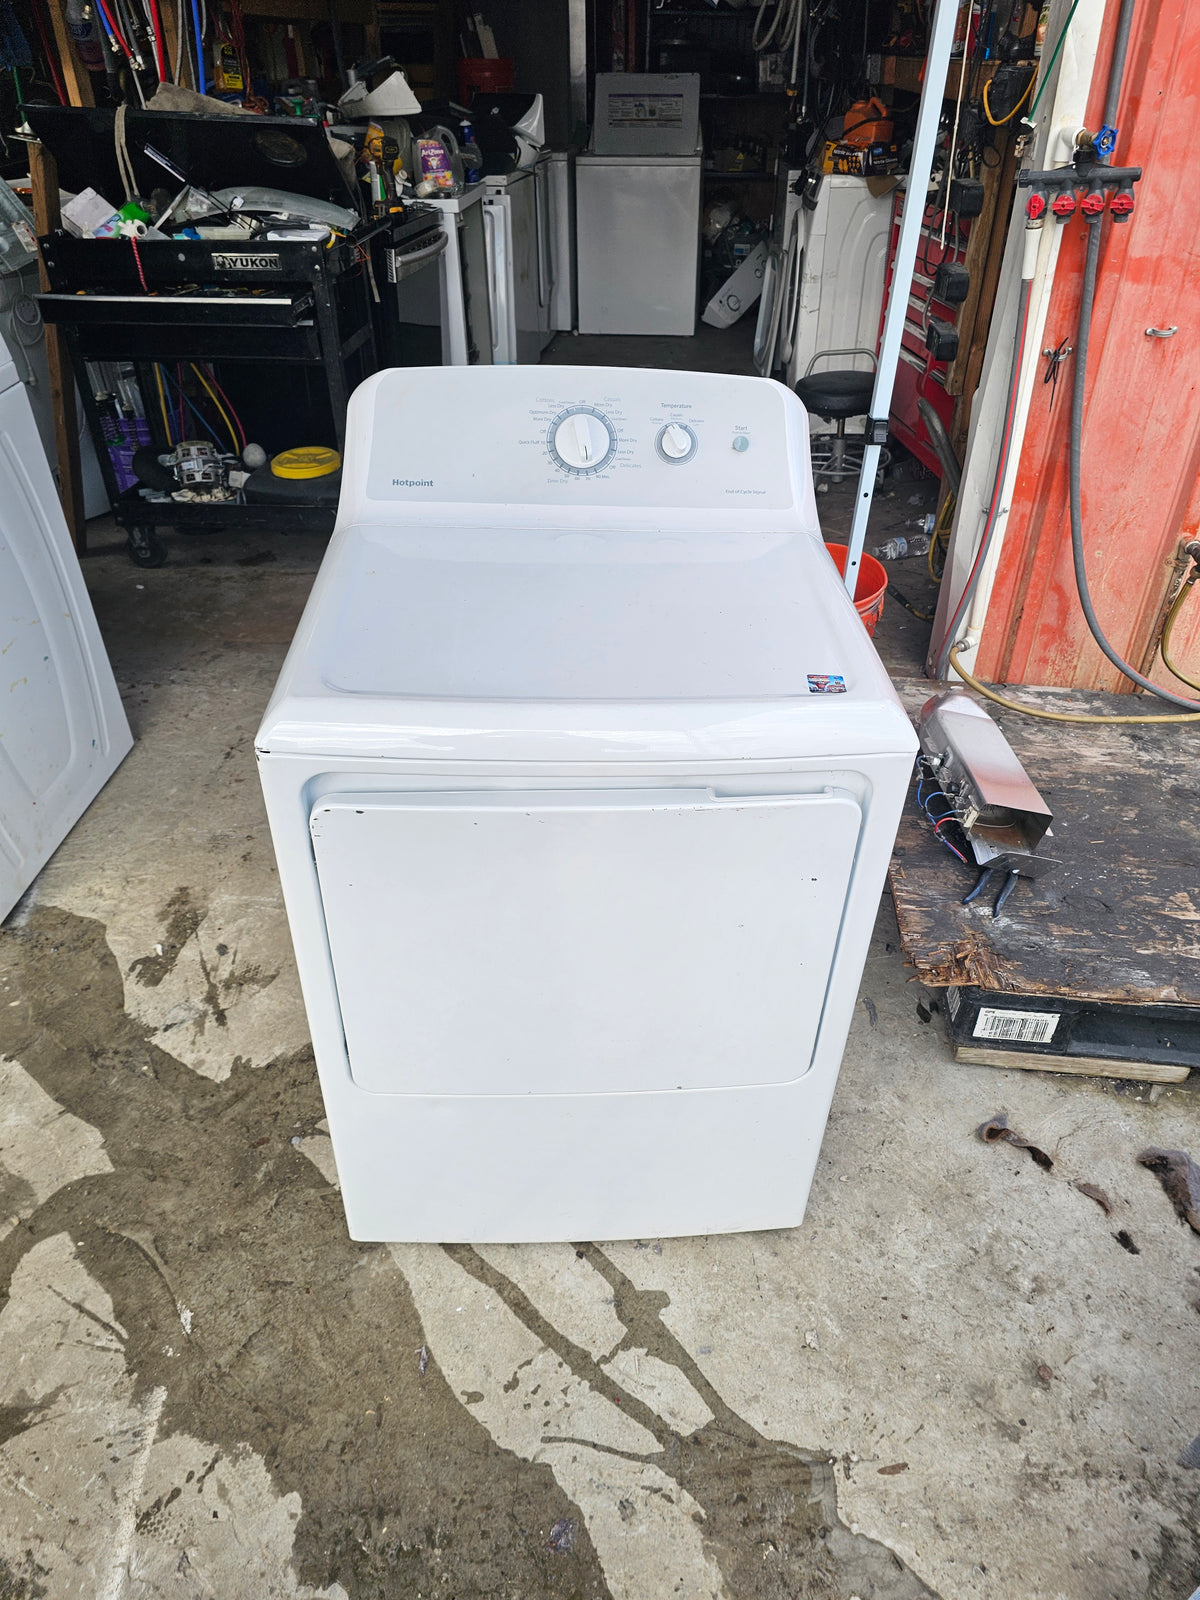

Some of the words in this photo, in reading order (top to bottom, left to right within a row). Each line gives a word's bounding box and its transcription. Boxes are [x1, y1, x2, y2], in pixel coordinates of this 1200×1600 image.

[421, 148, 444, 157] AriZona
[229, 257, 279, 268] YUKON
[392, 479, 434, 487] Hotpoint
